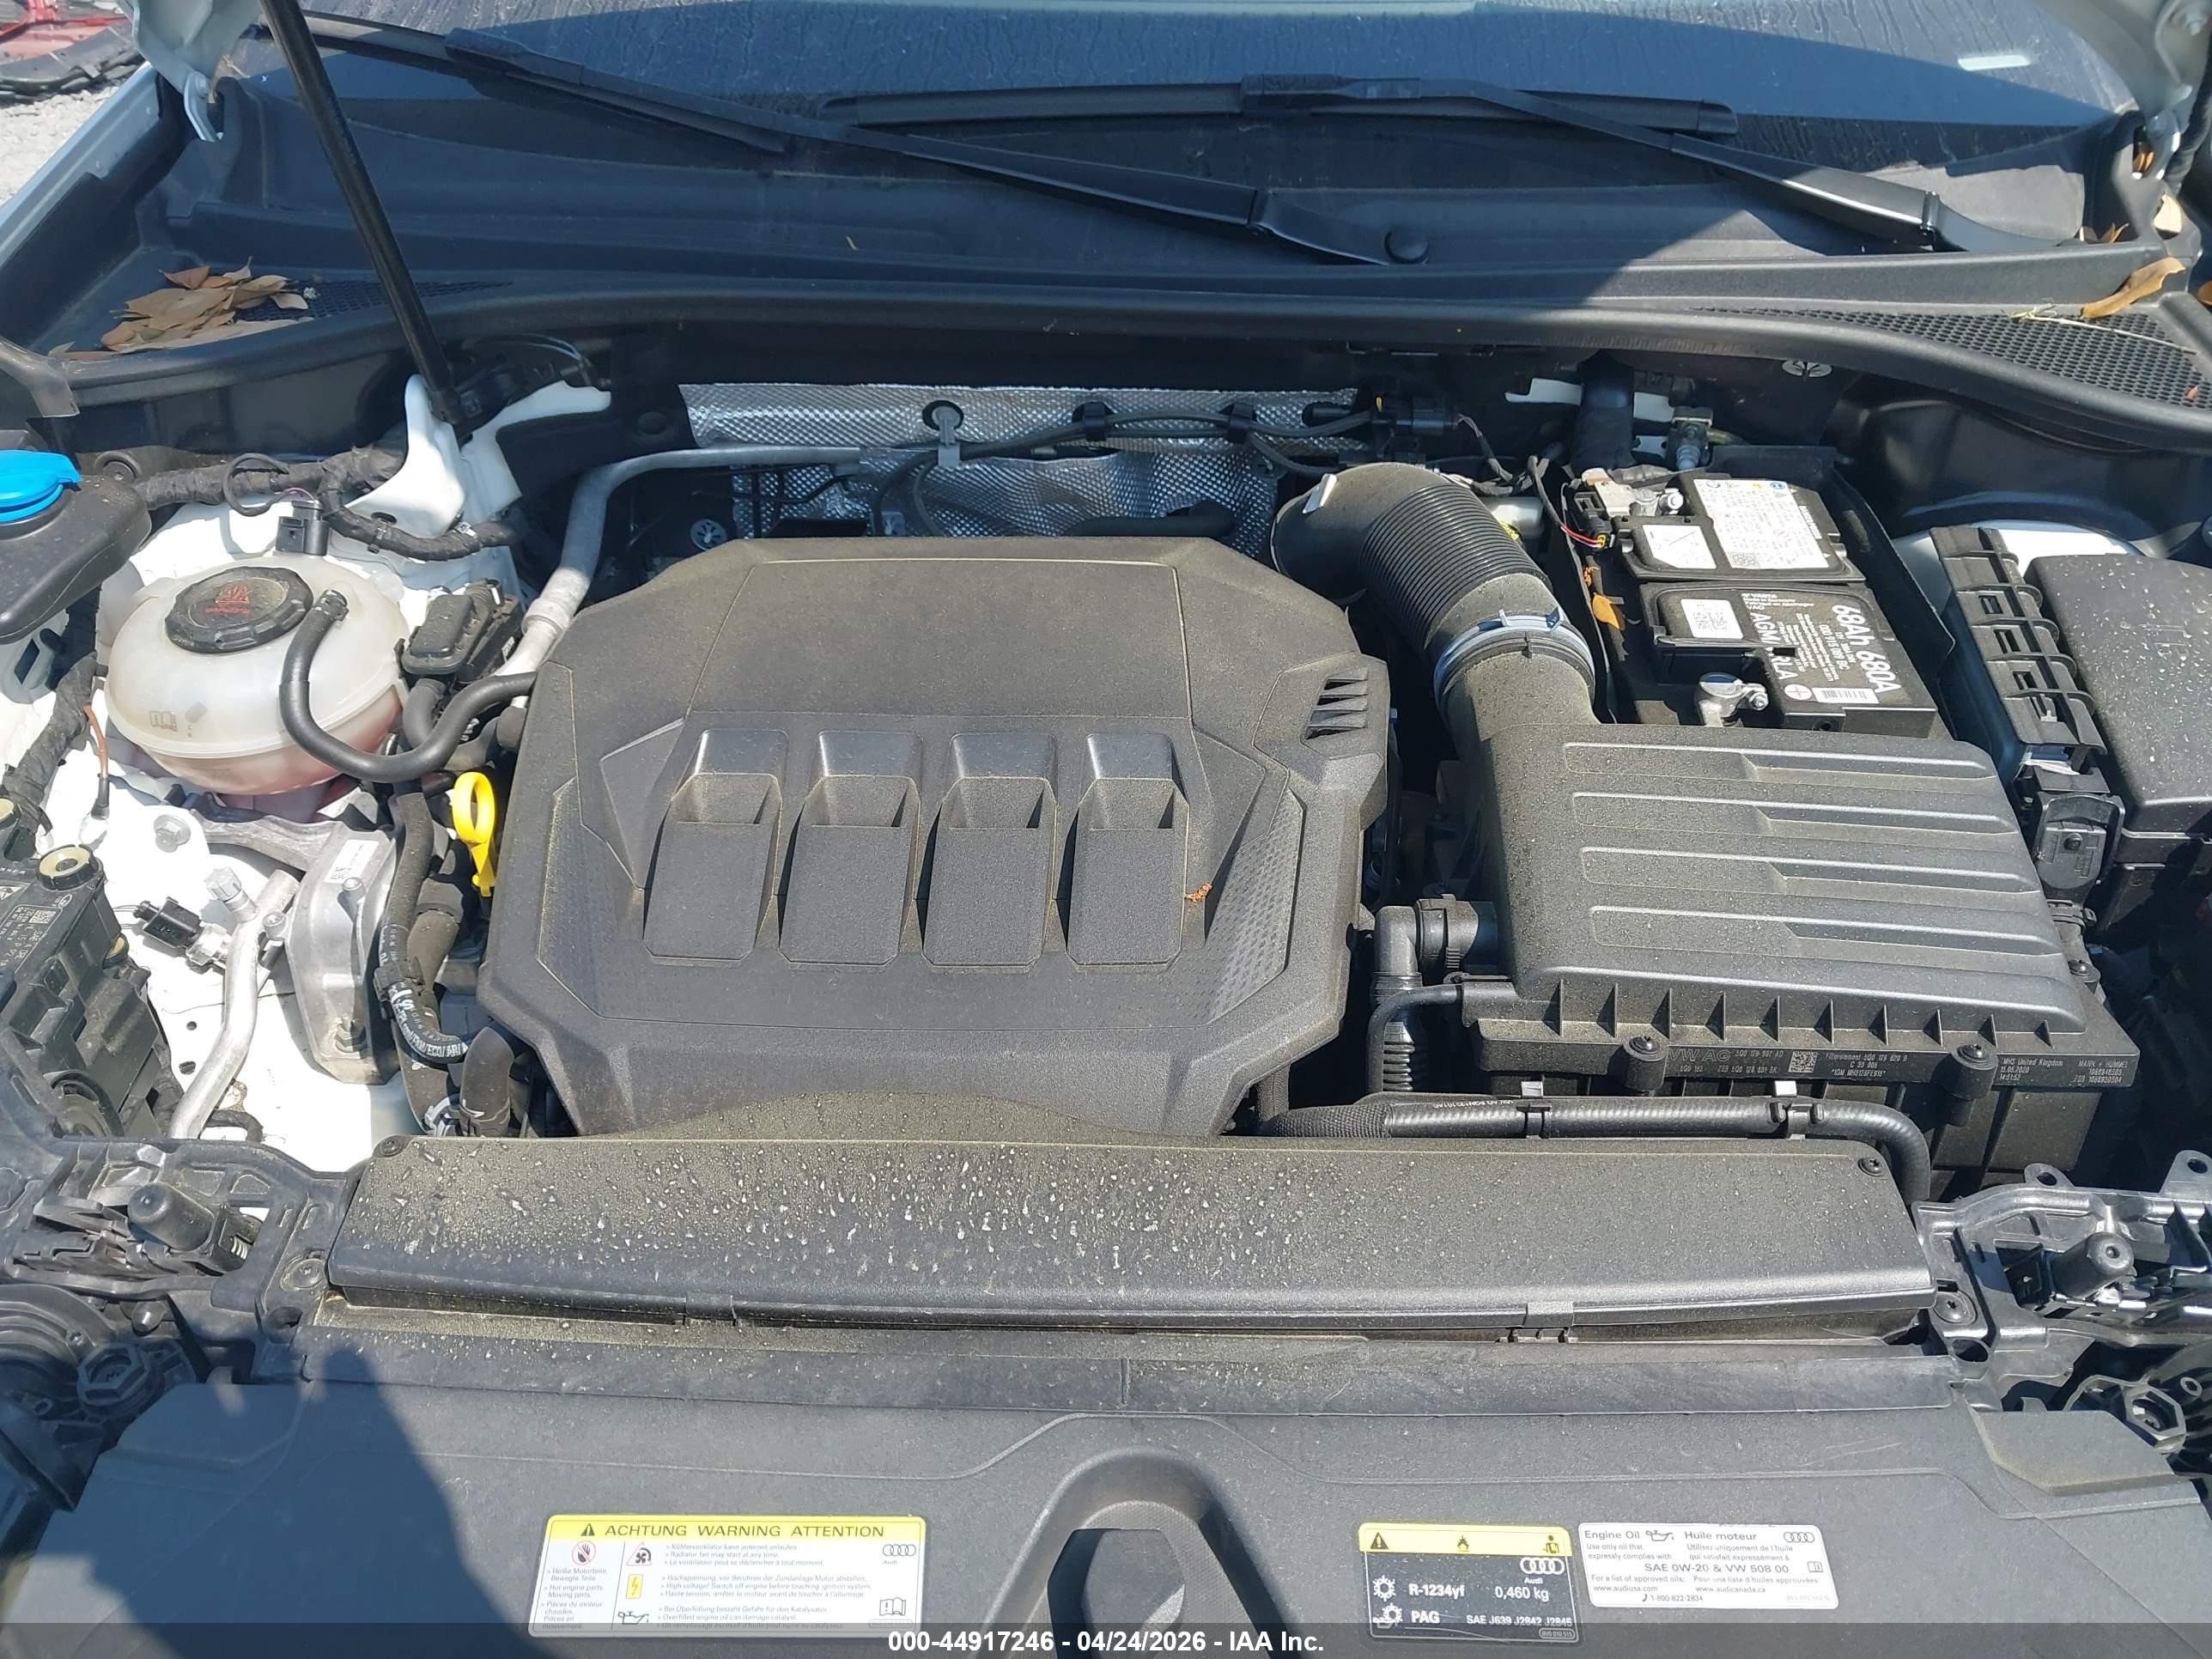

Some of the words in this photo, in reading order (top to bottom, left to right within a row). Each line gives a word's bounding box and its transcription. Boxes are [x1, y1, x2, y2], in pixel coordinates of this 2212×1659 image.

[1832, 605, 1875, 646] 68Ah
[1855, 650, 1902, 694] 680A
[1668, 1048, 1699, 1062] VW
[1702, 1049, 1732, 1062] AG
[2039, 1059, 2063, 1067] Kingdom
[605, 1525, 687, 1537] ACHTUNG
[697, 1525, 781, 1537] WARNING
[791, 1525, 884, 1537] ATTENTION
[1584, 1530, 1622, 1540] Engine
[1626, 1530, 1640, 1540] Oil
[1685, 1531, 1712, 1540] Huile
[1716, 1532, 1757, 1540] moteur
[1644, 1563, 1668, 1572] SAE
[1671, 1564, 1709, 1572] 0W-20
[1712, 1564, 1722, 1572] &
[1725, 1564, 1746, 1573] VW
[1751, 1565, 1771, 1573] 508
[1775, 1565, 1790, 1573] 00
[1408, 1583, 1465, 1599] R-1234yf
[1494, 1586, 1531, 1600] 0,460
[1534, 1587, 1550, 1602] kg
[1411, 1610, 1441, 1624] PAG
[1467, 1615, 1487, 1625] SAE
[1489, 1616, 1512, 1626] J639
[1514, 1617, 1542, 1626] J2842
[1545, 1618, 1573, 1627] J2845
